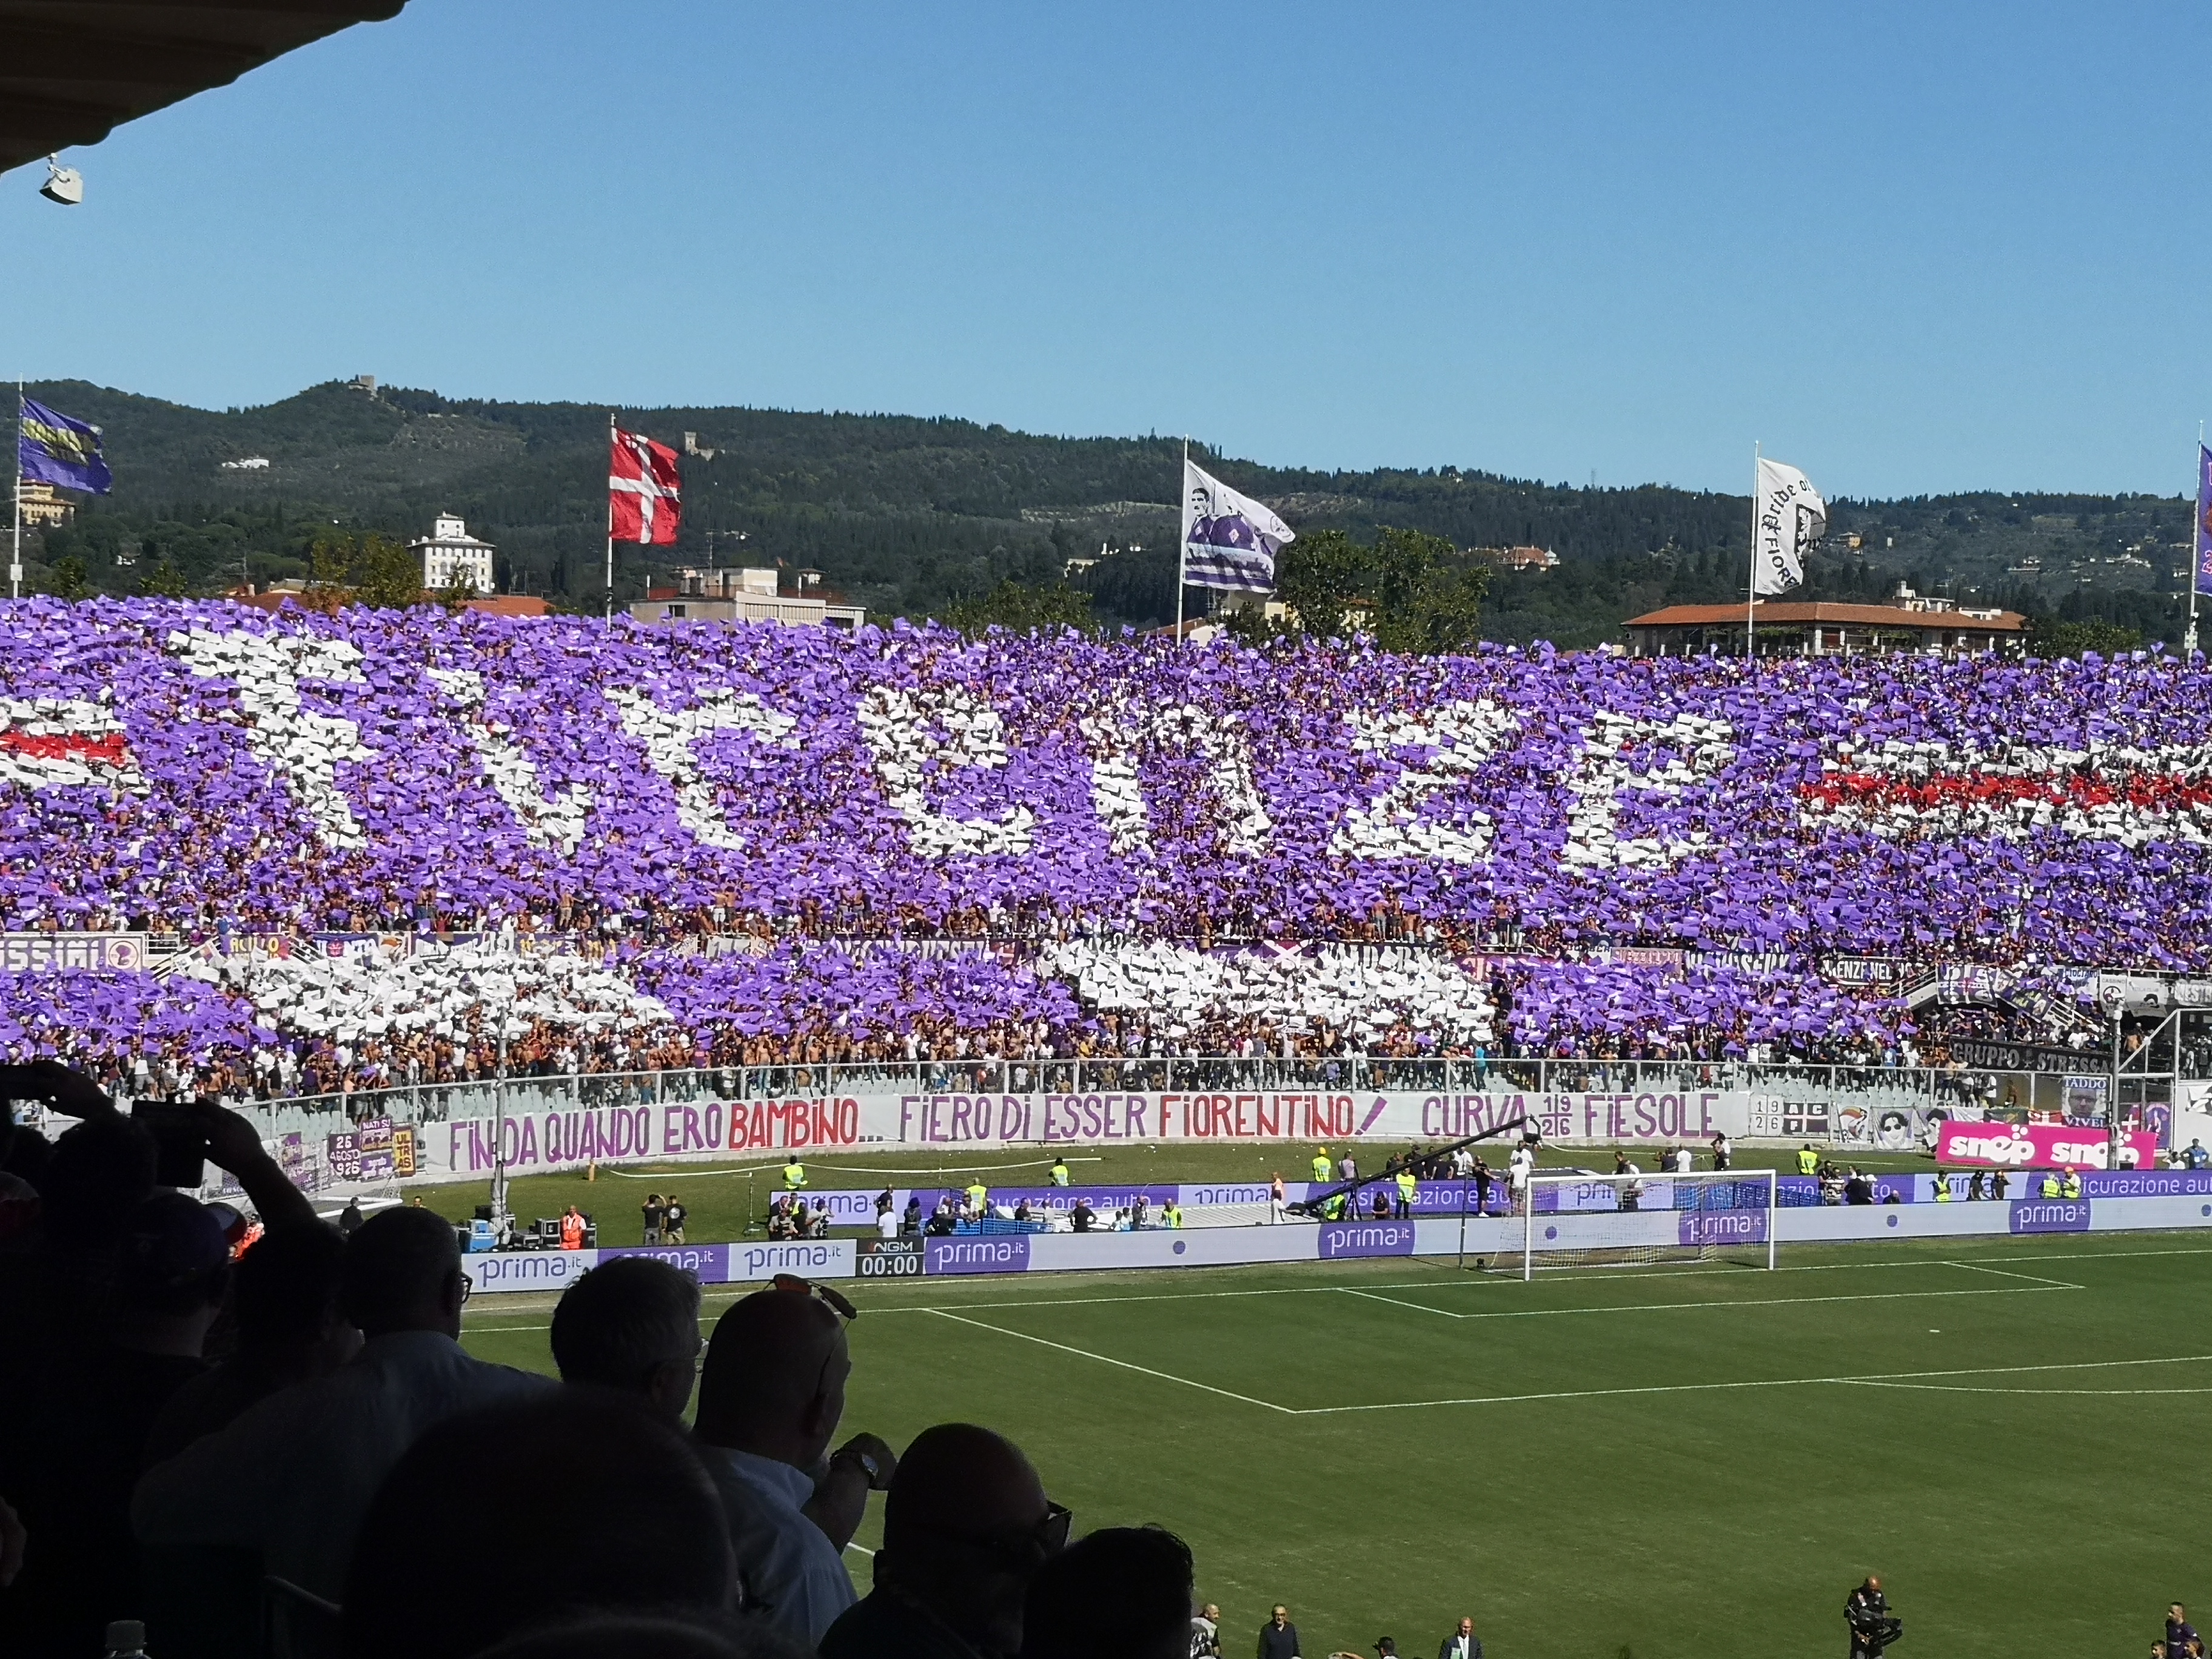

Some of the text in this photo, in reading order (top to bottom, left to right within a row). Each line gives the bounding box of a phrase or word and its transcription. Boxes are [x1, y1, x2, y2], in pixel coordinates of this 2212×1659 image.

[1953, 1042, 2020, 1068] GRUPPO
[2065, 1079, 2106, 1090] TADDO
[336, 1135, 352, 1149] 26
[504, 1116, 538, 1168] DA
[545, 1106, 651, 1164] QUANDO
[663, 1102, 723, 1153] ERO
[1044, 1095, 1147, 1139] ESSER
[1421, 1094, 1528, 1138] CURVA
[330, 1148, 360, 1161] AGOSTO
[2017, 1203, 2086, 1229] prima.it
[873, 1241, 913, 1253] NGM
[1327, 1227, 1410, 1255] prima.it
[745, 1245, 841, 1276] prima.it
[862, 1256, 917, 1275] 00:00
[934, 1241, 1024, 1270] prima.it
[478, 1256, 581, 1287] prima.it
